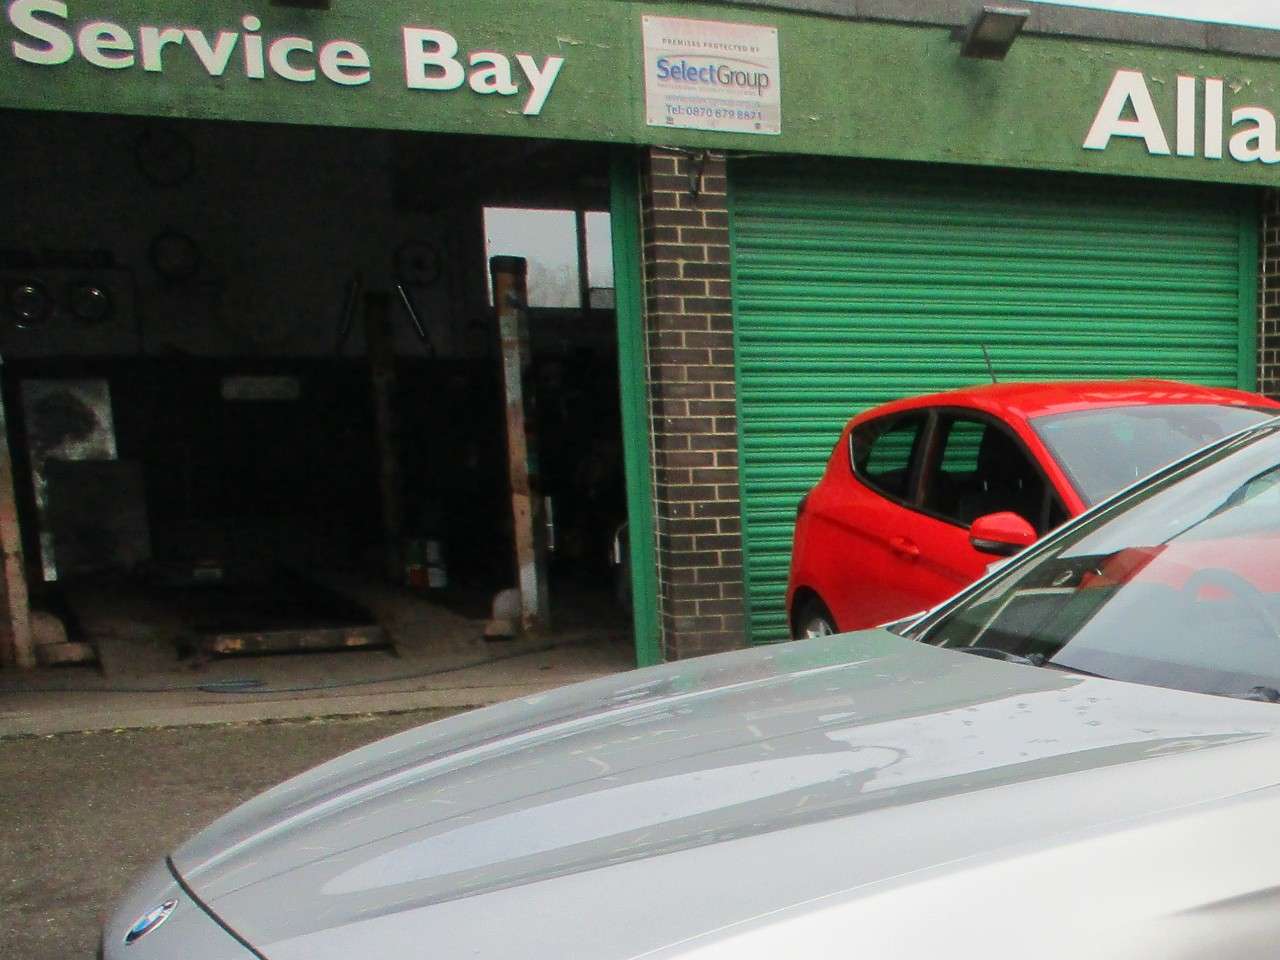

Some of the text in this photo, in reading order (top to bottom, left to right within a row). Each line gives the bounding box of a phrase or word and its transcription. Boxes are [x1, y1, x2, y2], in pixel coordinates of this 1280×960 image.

[9, 0, 565, 117] Service Bay
[656, 57, 769, 96] SelectGroup
